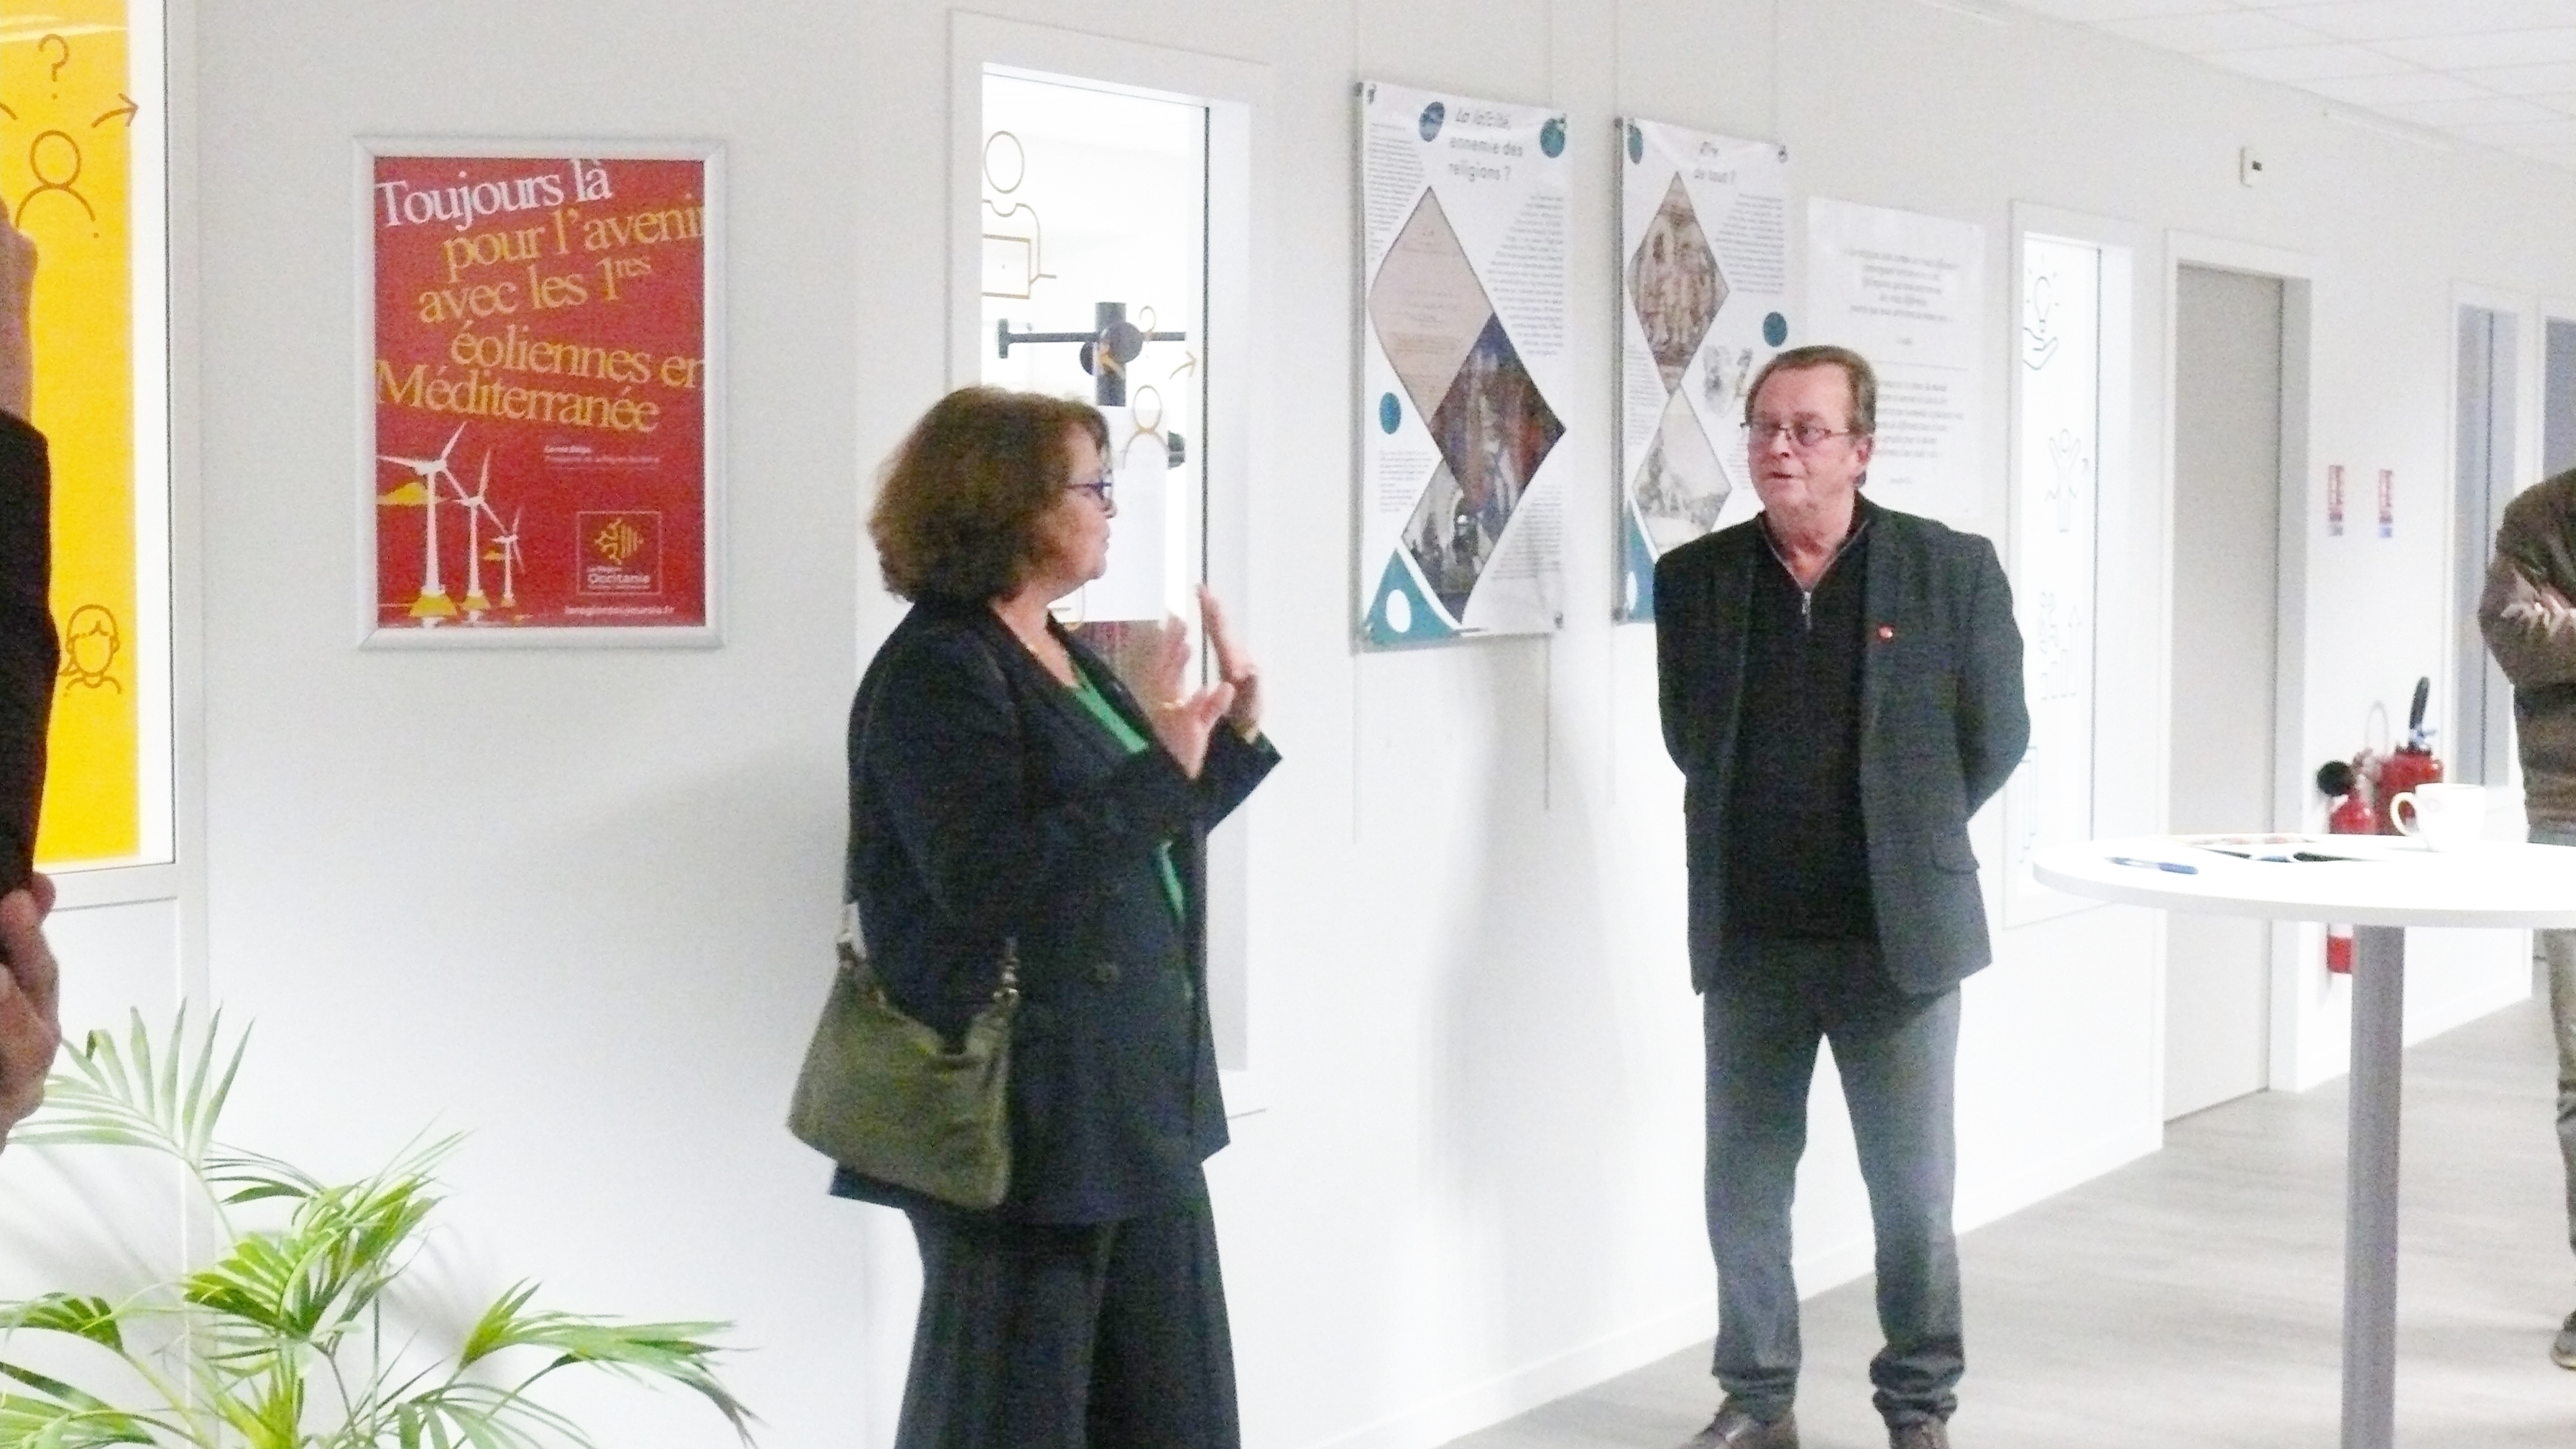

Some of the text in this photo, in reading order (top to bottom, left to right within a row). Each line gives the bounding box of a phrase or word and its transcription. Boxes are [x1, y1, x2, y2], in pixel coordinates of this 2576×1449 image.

[1502, 140, 1524, 157] des
[374, 159, 613, 231] Toujours là
[441, 225, 546, 284] pour
[418, 280, 518, 324] avec
[526, 264, 589, 310] les
[451, 319, 652, 385] éoliennes
[375, 359, 661, 433] Méditerranée
